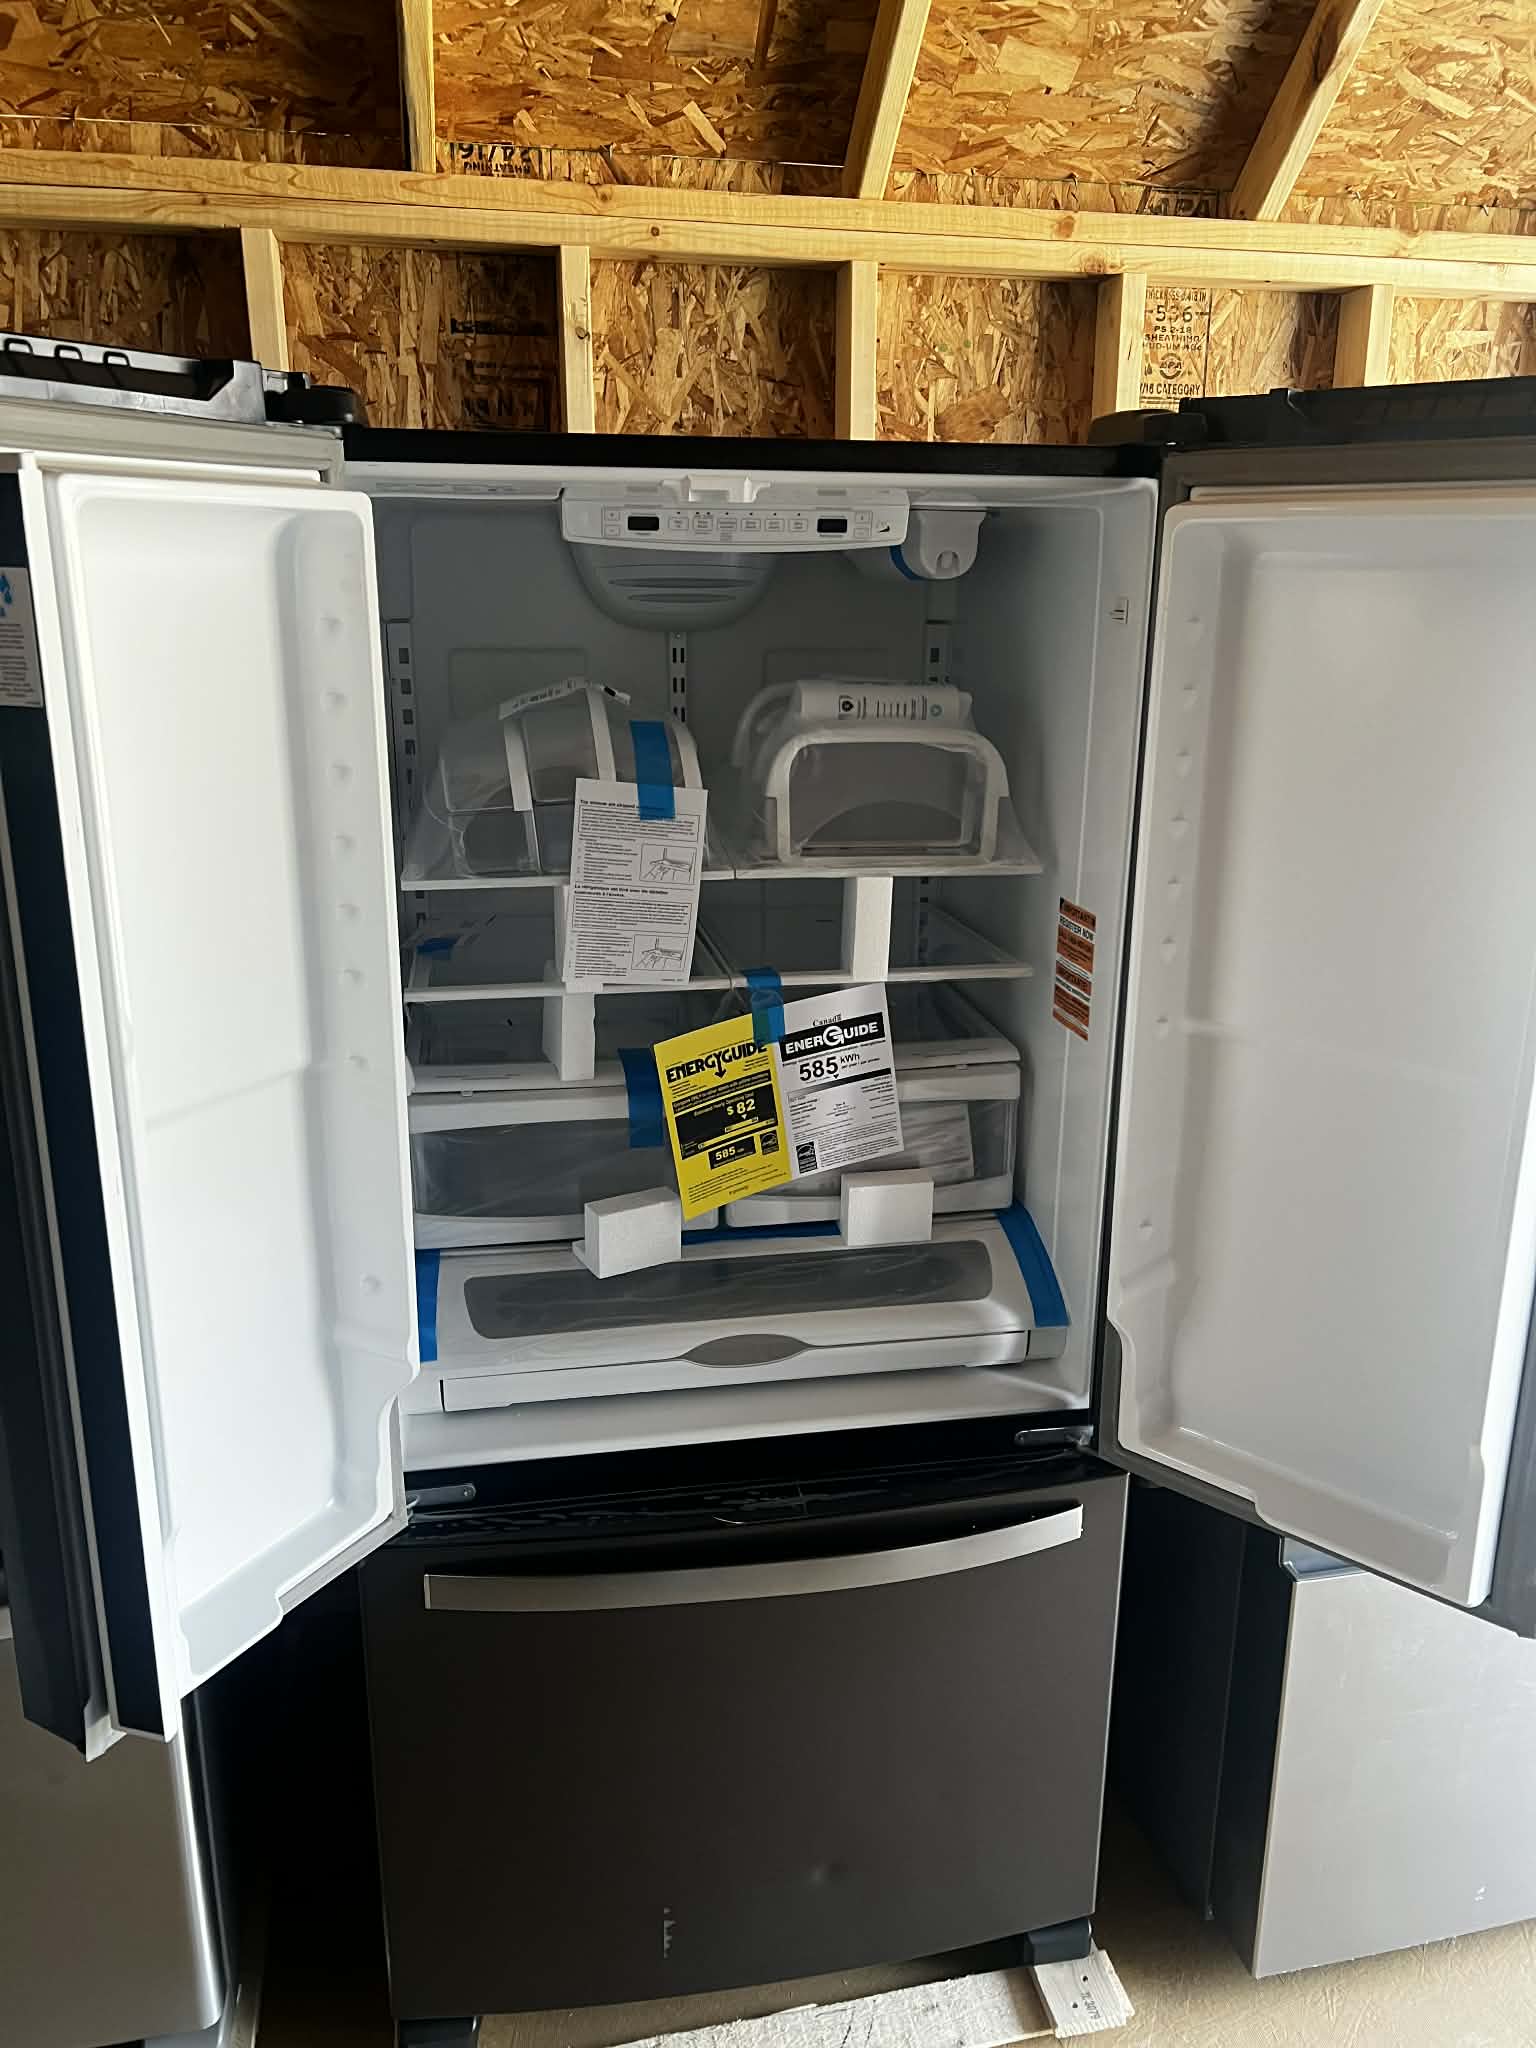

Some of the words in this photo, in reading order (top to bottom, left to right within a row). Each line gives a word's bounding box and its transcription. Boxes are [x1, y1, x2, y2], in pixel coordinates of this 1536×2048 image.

[1154, 325, 1167, 333] PS
[1156, 383, 1201, 396] CATEGORY
[785, 1021, 879, 1055] ENERGUIDE
[800, 1056, 839, 1081] 585
[840, 1053, 860, 1063] kWh
[736, 1098, 756, 1114] 82
[715, 1146, 736, 1160] 585
